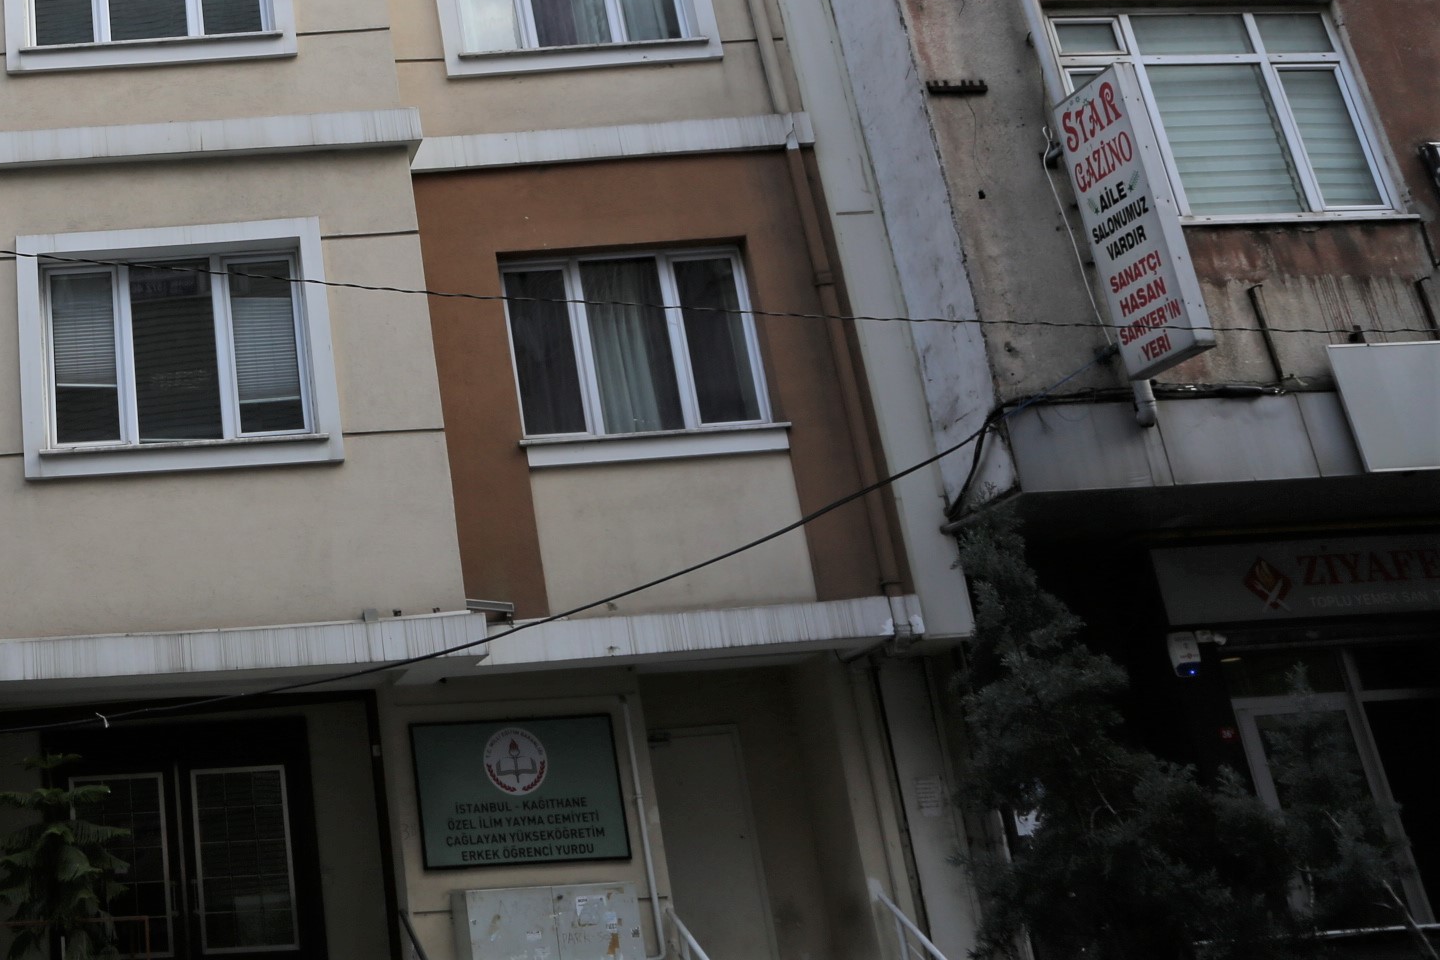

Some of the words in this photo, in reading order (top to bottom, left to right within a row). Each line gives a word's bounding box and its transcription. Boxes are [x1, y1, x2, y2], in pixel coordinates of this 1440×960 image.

[1062, 81, 1122, 152] STAR
[1074, 131, 1133, 193] GAZİNO
[1099, 181, 1128, 213] AİLE
[1092, 196, 1149, 245] SALONUMUZ
[1106, 225, 1148, 261] VARDIR
[1109, 249, 1162, 295] SANATÇI
[1119, 276, 1167, 318] HASAN
[1119, 296, 1181, 347] SARIYER'İN
[1140, 333, 1172, 362] YERİ
[1310, 596, 1352, 609] TOPLU
[1354, 593, 1401, 607] YEMEK
[447, 816, 477, 831] ÖZEL
[479, 814, 503, 829] İLİM
[506, 815, 545, 828] YAYMA
[547, 810, 600, 825] CEMİYETİ
[455, 798, 512, 815] İSTANBUL
[522, 796, 588, 811] KAĞITHANE
[446, 830, 507, 848] ÇAĞLAYAN
[509, 826, 606, 844] YÜKSEKÖĞRETİM
[461, 849, 500, 862] ERKEK
[502, 846, 554, 861] ÖĞRENCİ
[555, 843, 595, 856] YURDU
